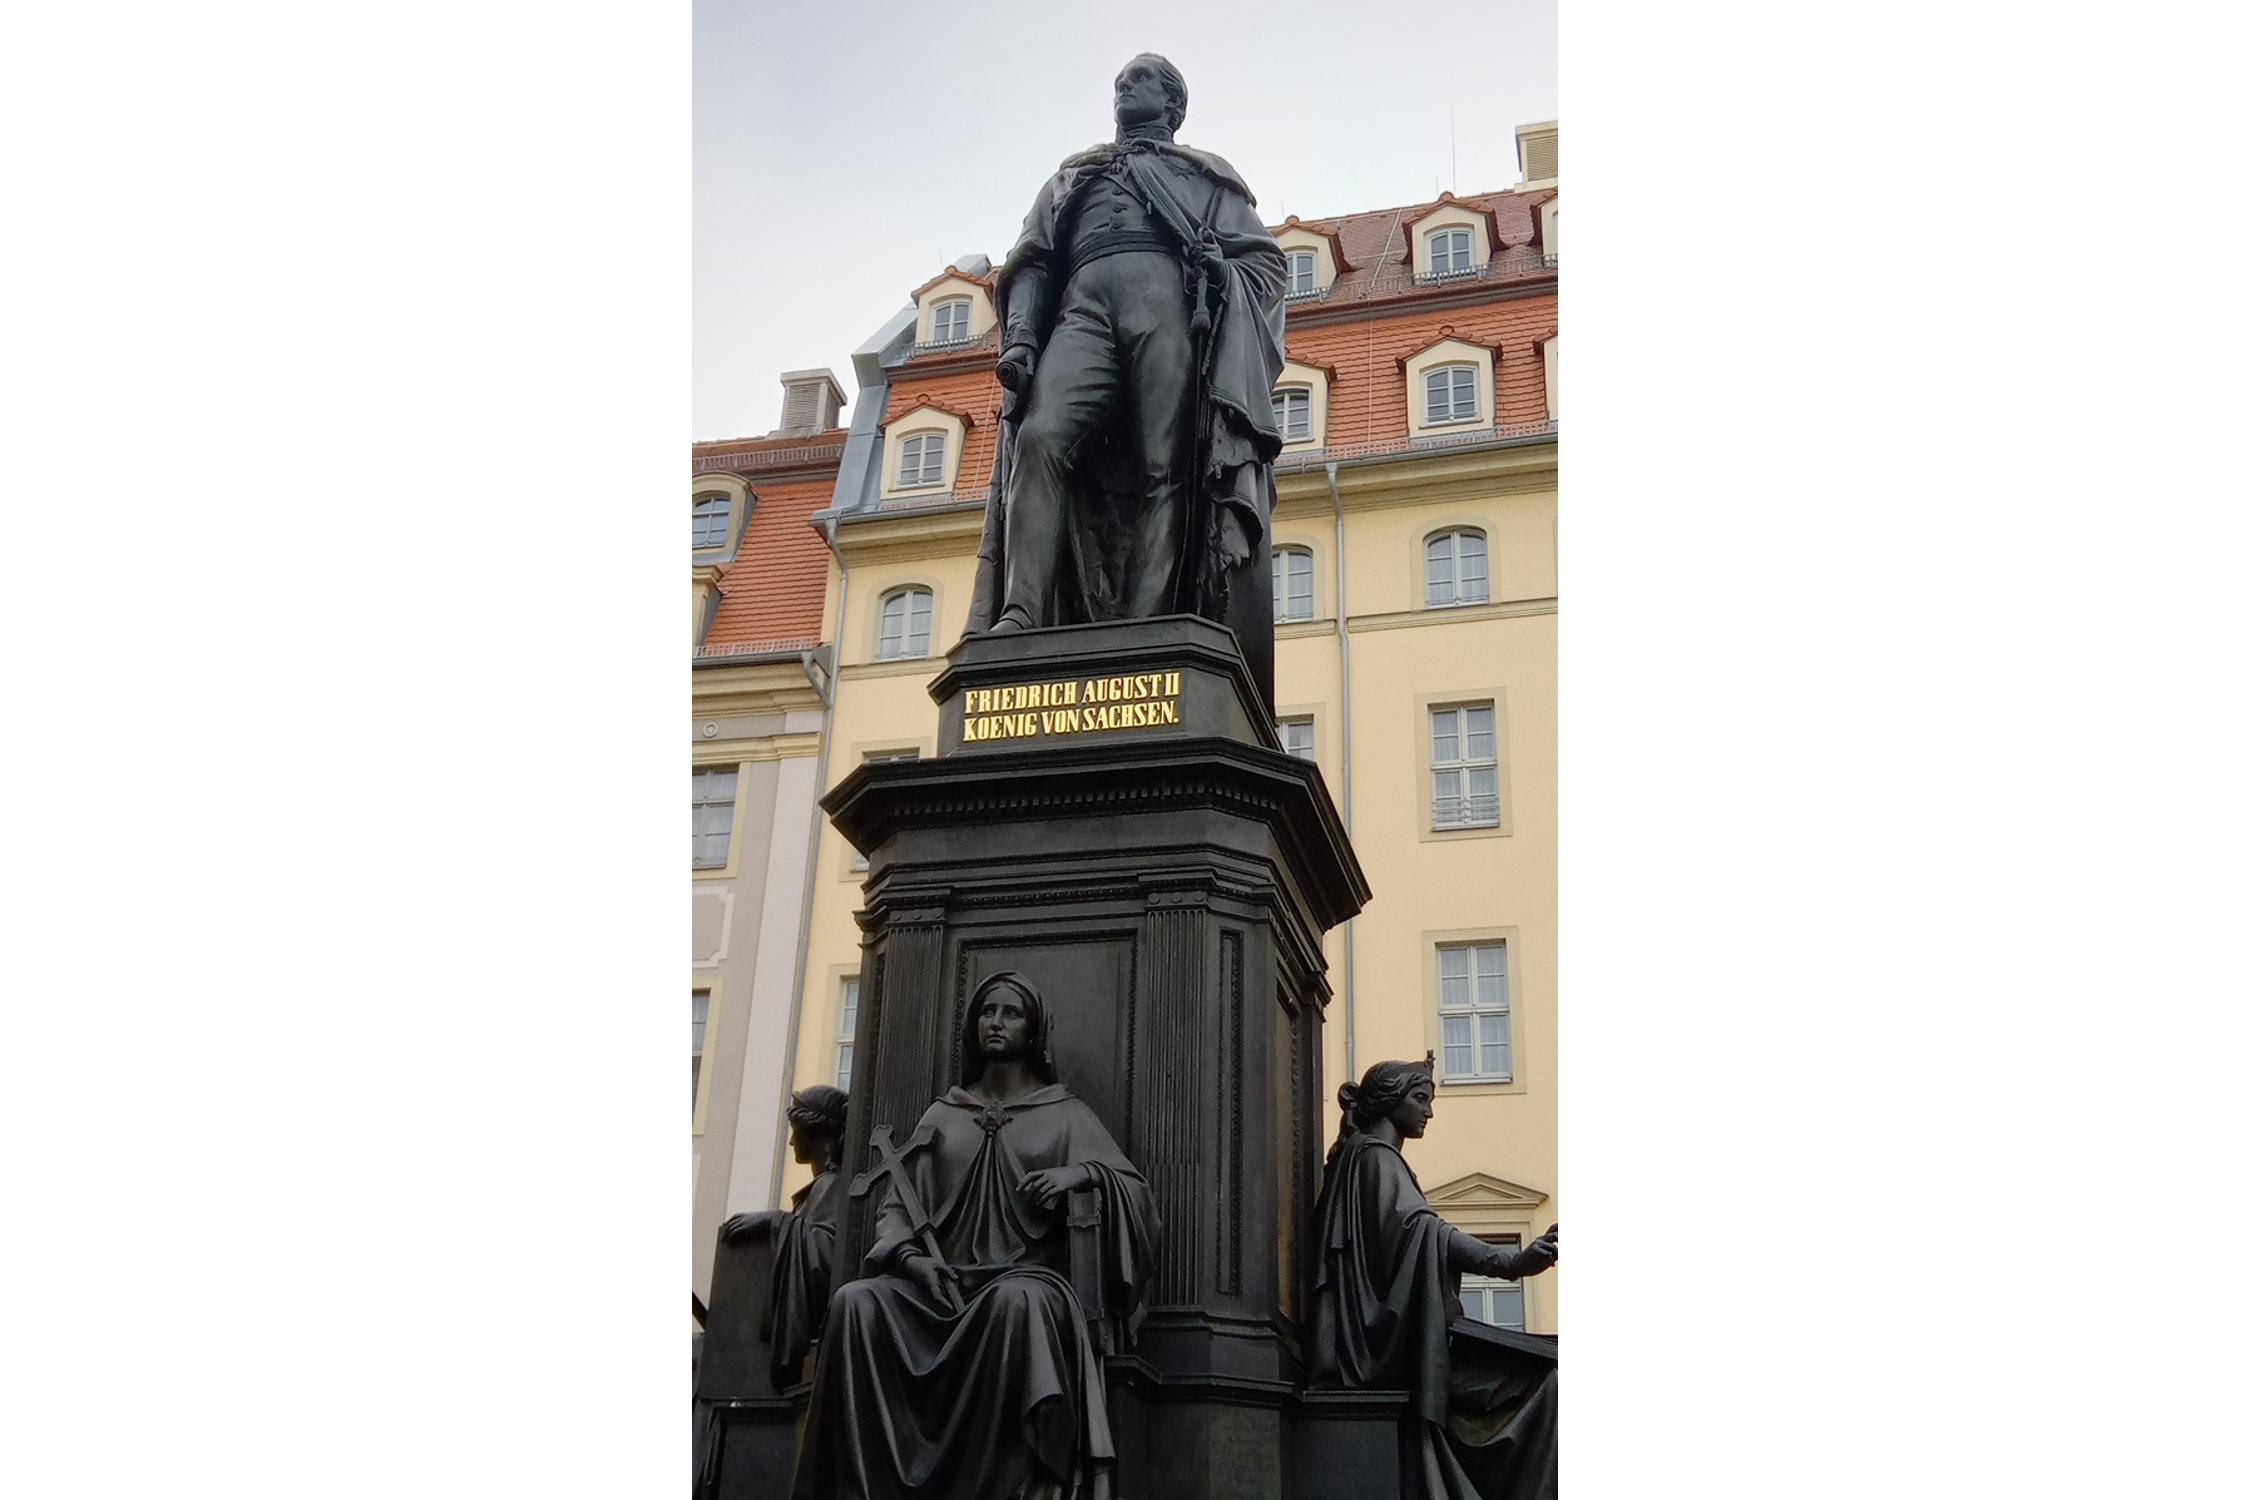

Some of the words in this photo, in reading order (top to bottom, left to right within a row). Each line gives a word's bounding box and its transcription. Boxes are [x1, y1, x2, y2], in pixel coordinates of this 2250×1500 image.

[965, 681, 1077, 714] FRIEDRICH
[1081, 674, 1161, 704] AUGUST
[1164, 672, 1181, 697] II
[963, 713, 1038, 742] KOENIG
[1040, 708, 1080, 734] VON
[1082, 701, 1179, 732] SACHSEN.
